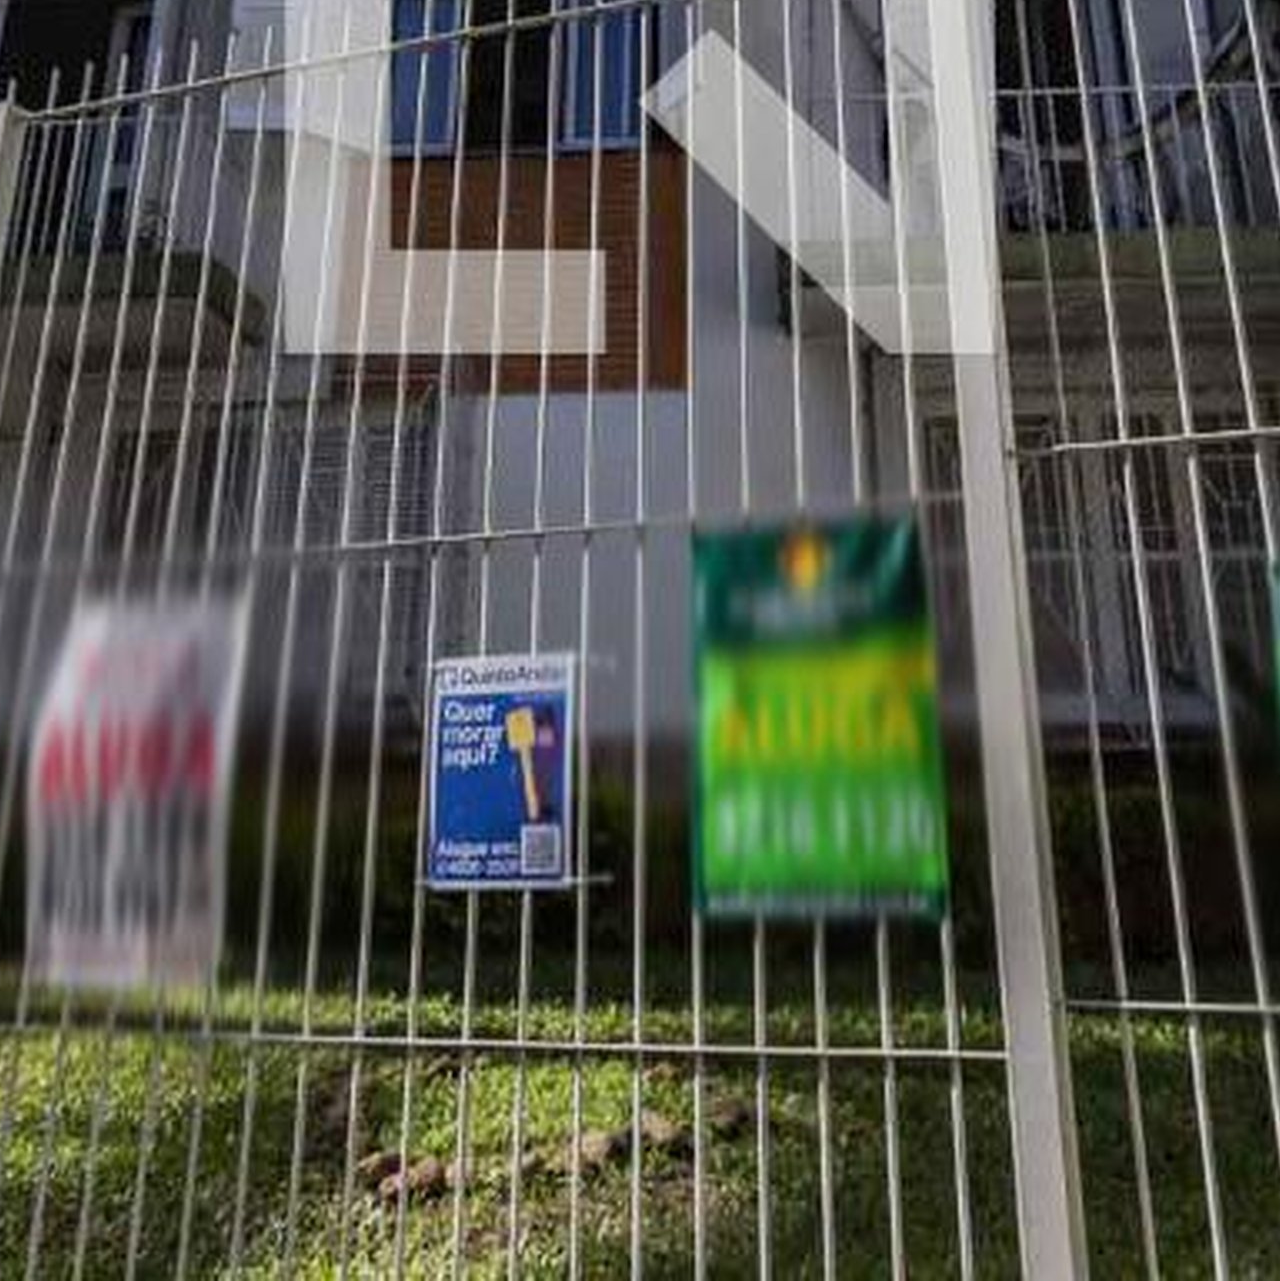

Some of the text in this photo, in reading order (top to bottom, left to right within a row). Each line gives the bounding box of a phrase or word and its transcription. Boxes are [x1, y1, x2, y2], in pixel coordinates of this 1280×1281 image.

[461, 663, 560, 686] QuintoAnd
[443, 700, 495, 721] Quer
[442, 726, 503, 743] morar
[441, 745, 498, 771] aqui?
